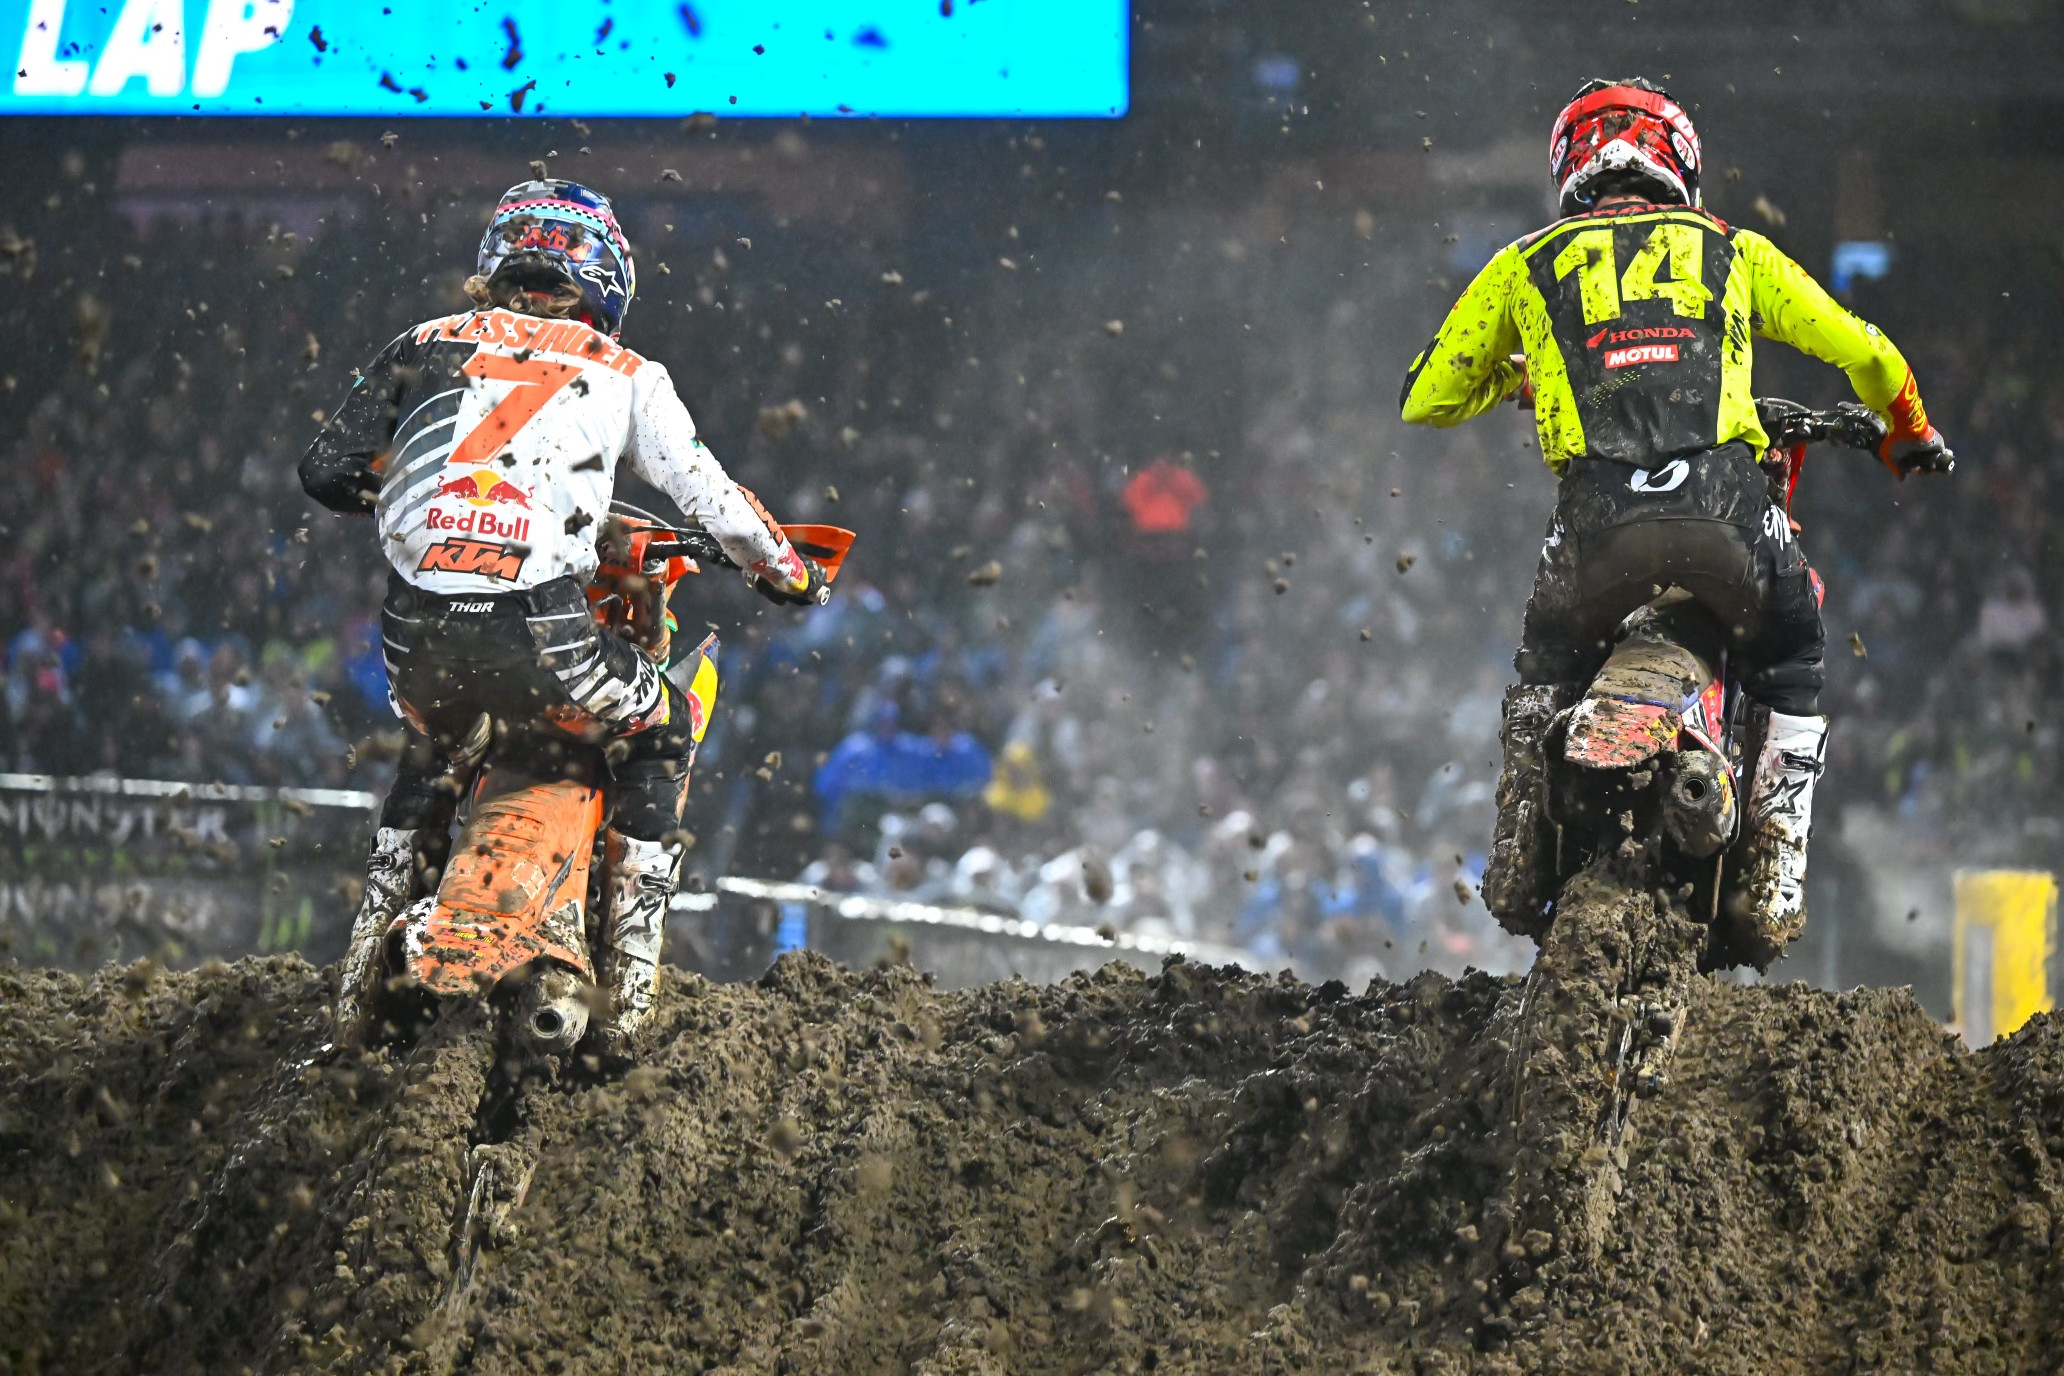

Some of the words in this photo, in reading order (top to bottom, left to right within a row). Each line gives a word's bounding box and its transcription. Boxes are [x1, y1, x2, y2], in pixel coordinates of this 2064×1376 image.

[12, 0, 296, 98] LAP
[1553, 224, 1713, 325] 14
[1609, 327, 1697, 344] HONDA
[1608, 346, 1675, 367] MOTUL
[447, 352, 584, 465] 7
[426, 507, 477, 533] Red
[478, 511, 530, 542] Bull
[416, 537, 525, 583] KTM
[449, 602, 495, 613] THOR
